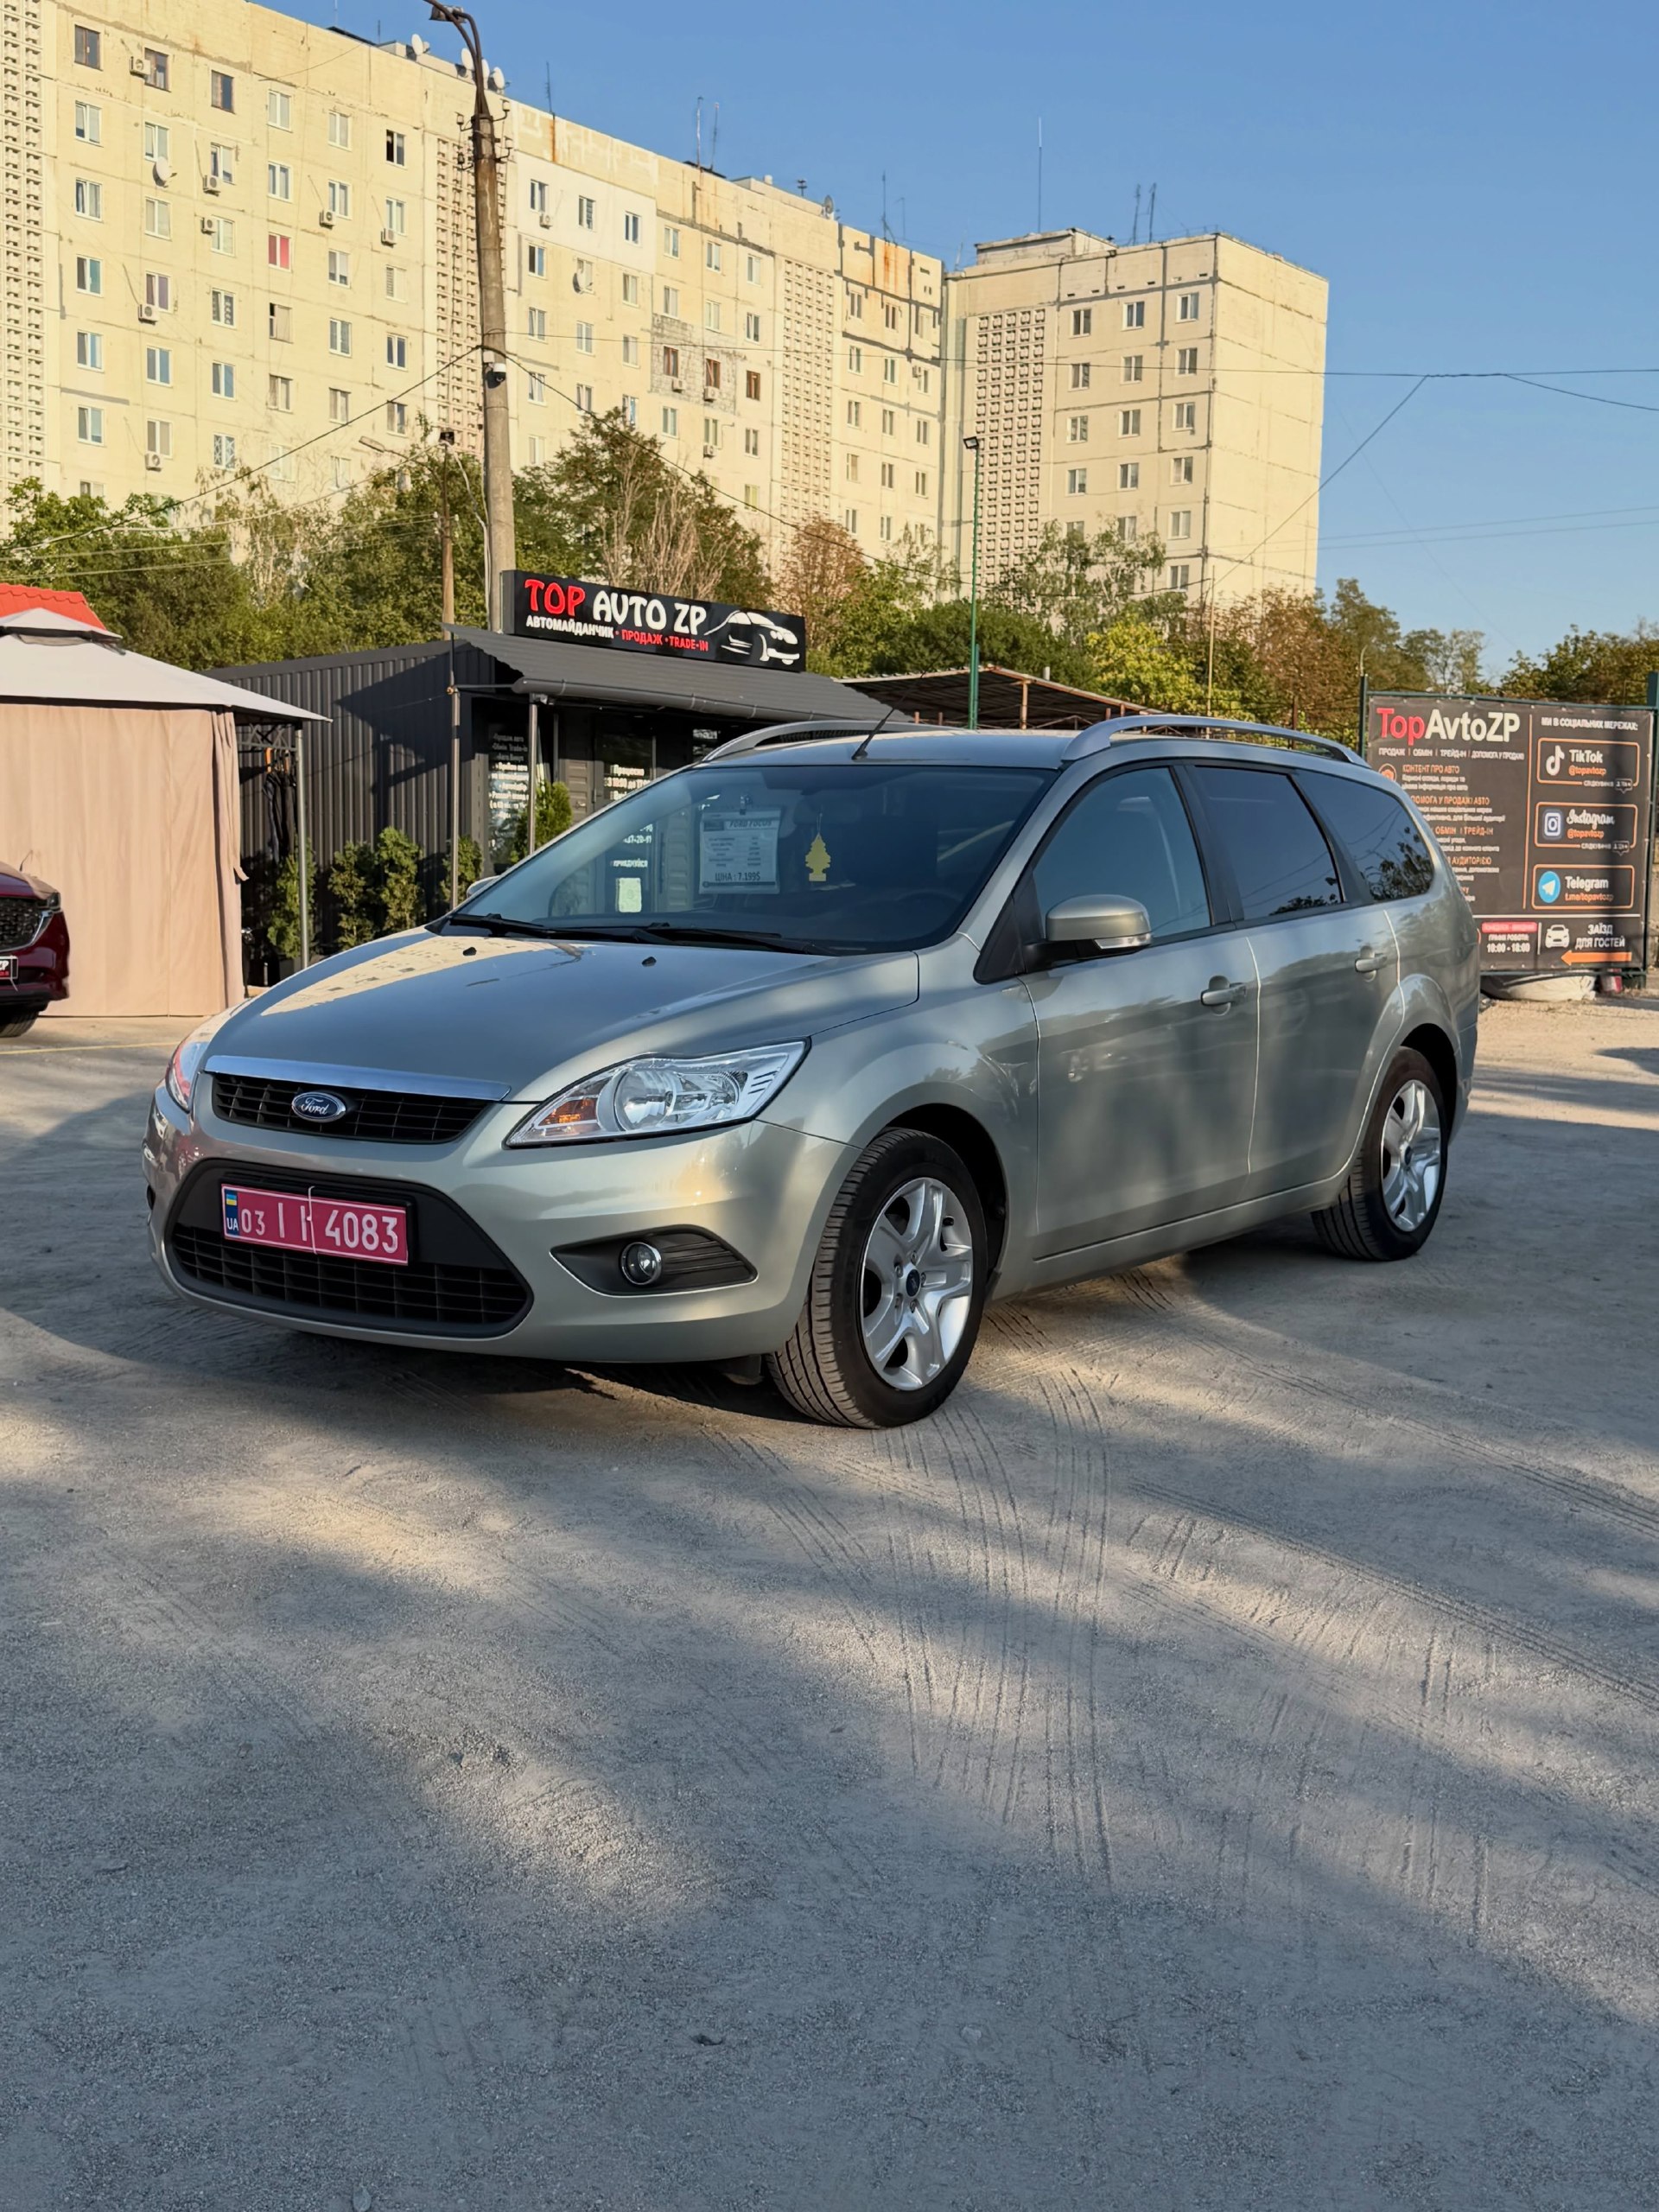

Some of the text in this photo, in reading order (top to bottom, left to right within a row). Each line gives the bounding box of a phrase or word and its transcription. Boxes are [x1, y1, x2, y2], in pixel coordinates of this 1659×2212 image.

[524, 579, 707, 635] TOP AVTO ZP
[525, 614, 663, 645] АВТОМАЙДАНЧИК ПРОДАЖ
[669, 636, 709, 652] TRADE-IN
[1376, 708, 1521, 746] TopAvtoZP
[1378, 747, 1406, 757] ПРОДАЖ
[1413, 748, 1433, 757] ОБМІН
[1569, 749, 1603, 763] TikTok
[1402, 764, 1460, 774] КОНТЕНТ ПРО АВТО
[1411, 796, 1437, 805] ПОМОГА
[1473, 797, 1491, 805] АВТО
[1567, 809, 1615, 830] Instagram
[1435, 825, 1456, 835] ОБМІН
[1565, 876, 1609, 892] Telegram
[1587, 922, 1613, 935] ЗАЇЗД
[1575, 935, 1625, 950] ДЛЯ ГОСТЕЙ
[301, 1096, 329, 1116] Ford
[226, 1217, 238, 1231] UA
[241, 1208, 265, 1236] 03
[325, 1210, 398, 1253] 4083
